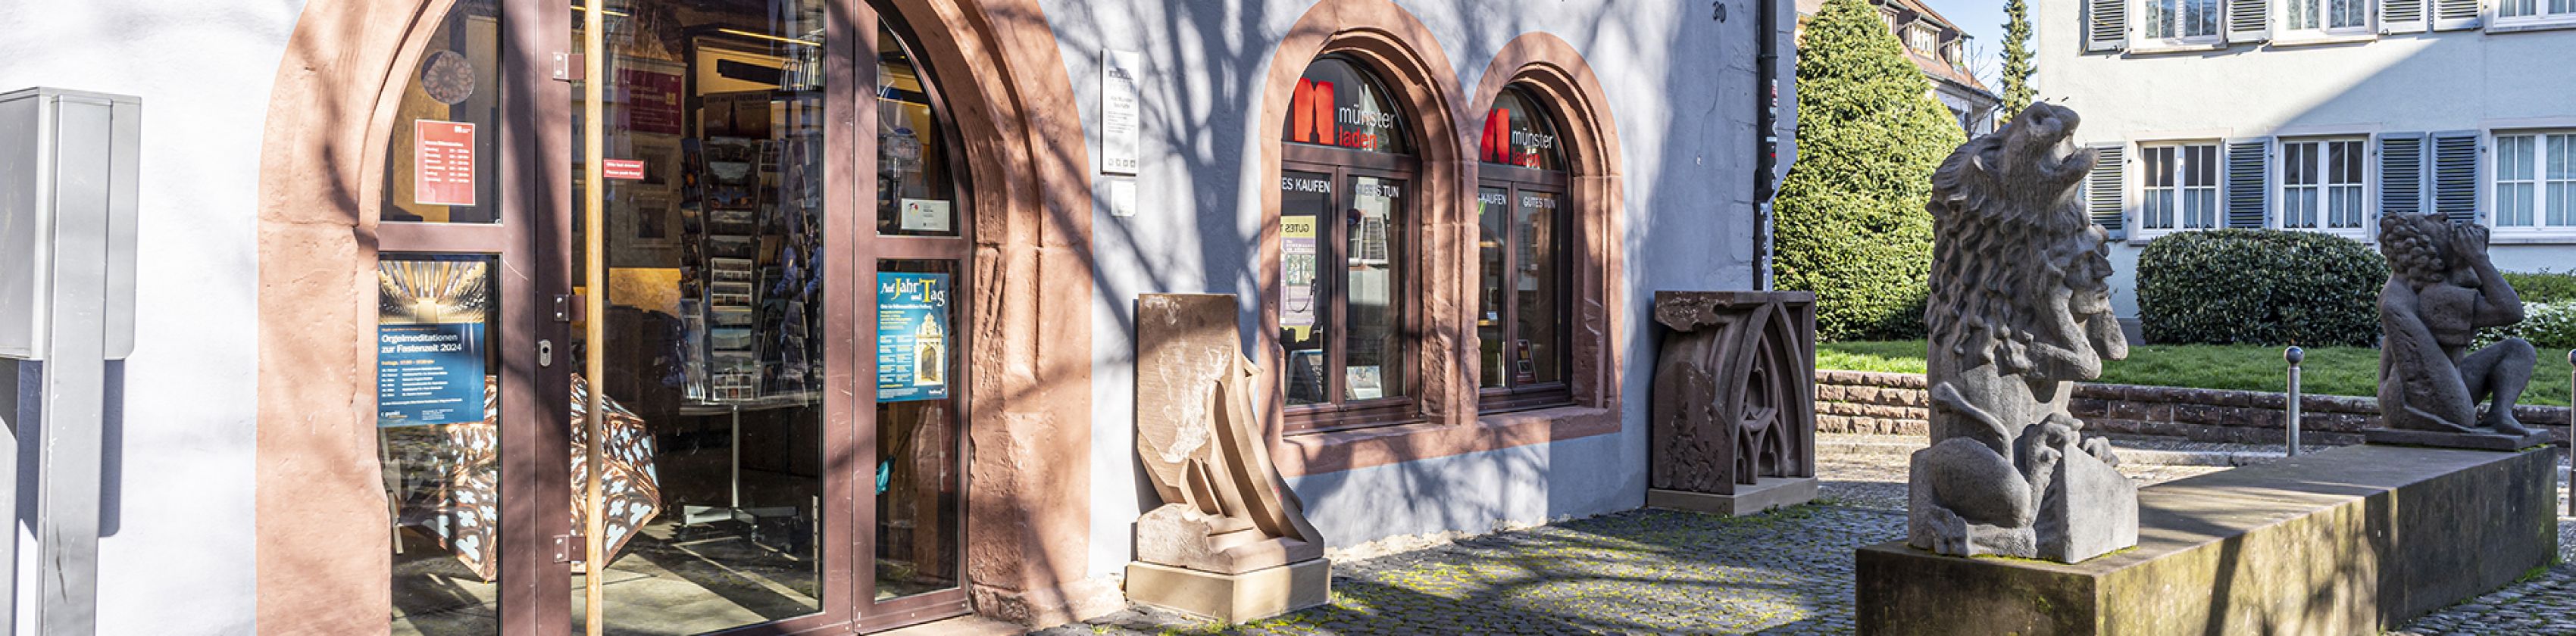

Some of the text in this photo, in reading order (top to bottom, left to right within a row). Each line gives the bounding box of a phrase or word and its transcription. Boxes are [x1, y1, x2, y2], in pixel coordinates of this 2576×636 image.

[1339, 104, 1396, 129] münster
[1339, 126, 1377, 150] laden
[1512, 126, 1553, 148] münster
[1512, 147, 1540, 169] laden
[1296, 179, 1330, 192] KAUFEN
[1383, 186, 1399, 198] TUN
[1523, 196, 1555, 208] GUTES TUN
[880, 278, 920, 301] Auf Jahr
[918, 278, 946, 307] Tag
[381, 333, 458, 344] Orgelmeditationen
[396, 344, 439, 353] Fastenzeit
[440, 343, 462, 352] 2024
